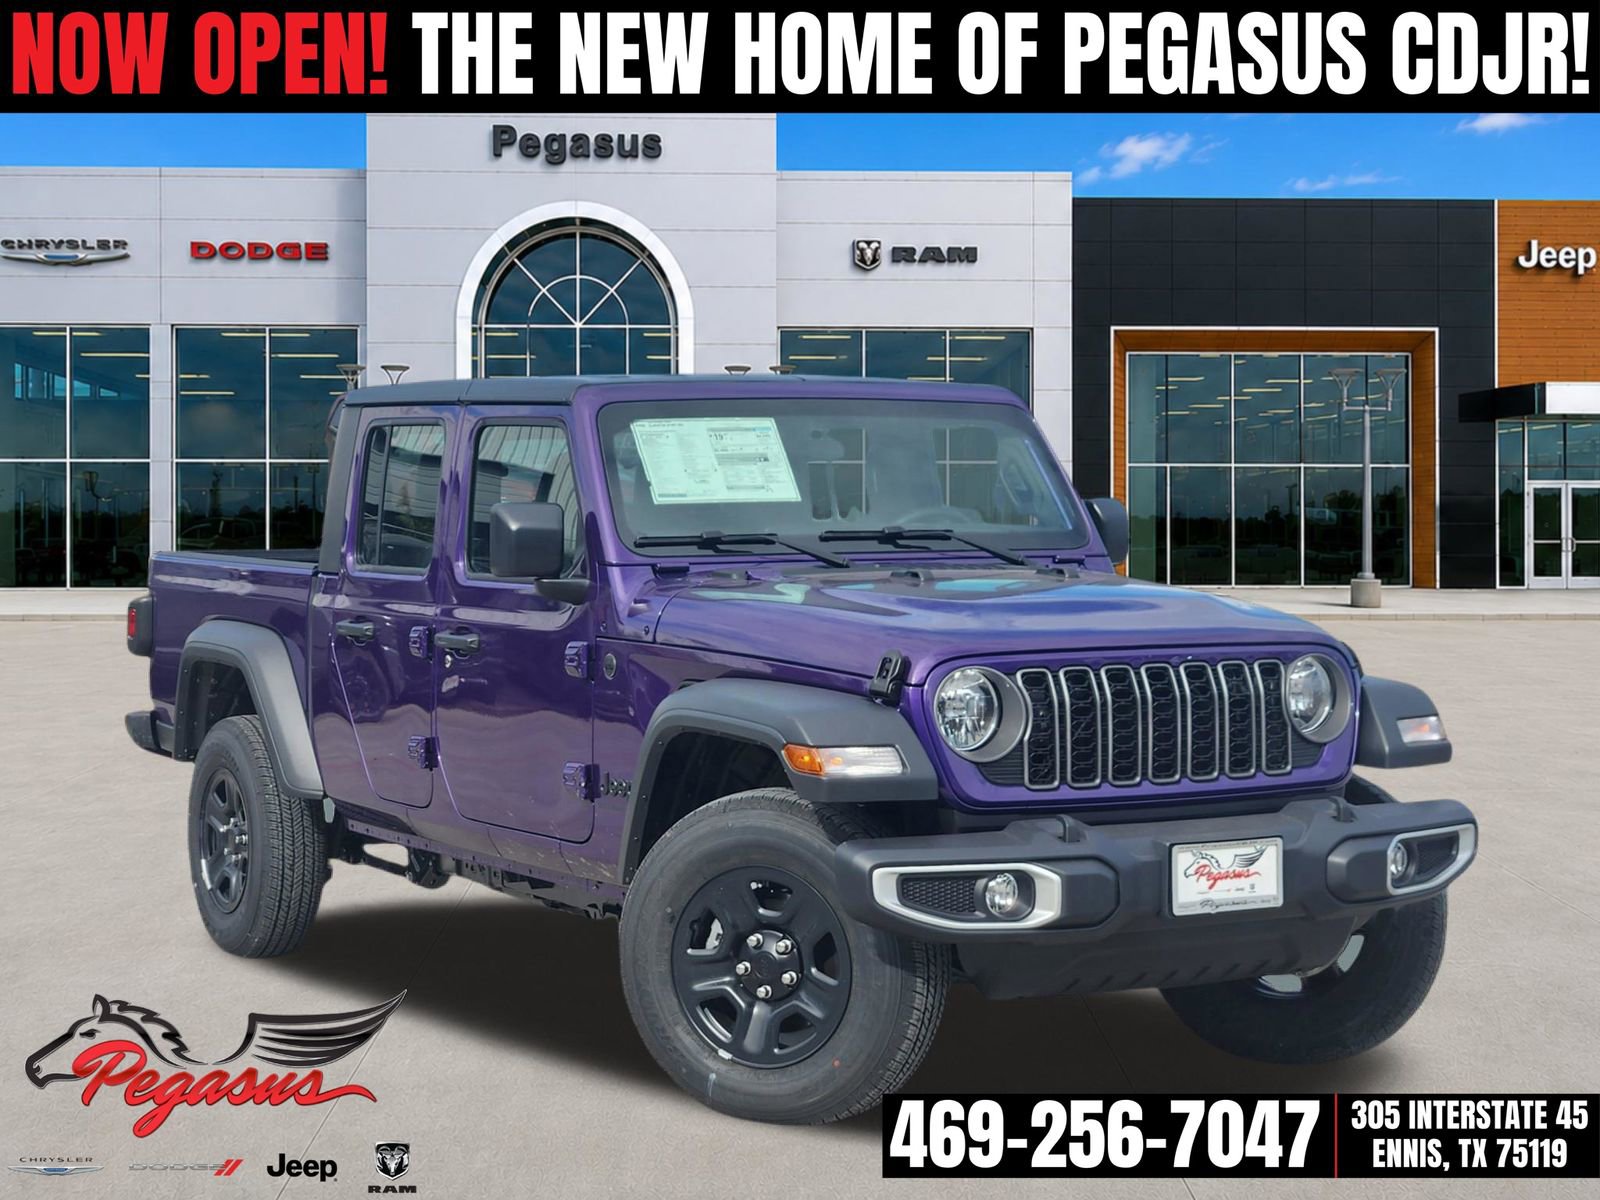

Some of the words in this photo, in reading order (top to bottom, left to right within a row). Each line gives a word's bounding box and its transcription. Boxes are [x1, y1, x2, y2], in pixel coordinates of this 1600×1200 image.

[492, 124, 662, 166] Pegasus
[1, 239, 128, 251] CHRYSLER
[190, 241, 329, 261] DODGE
[892, 245, 978, 264] RAM
[1518, 240, 1597, 275] Jeep
[1194, 864, 1261, 890] Pegasus
